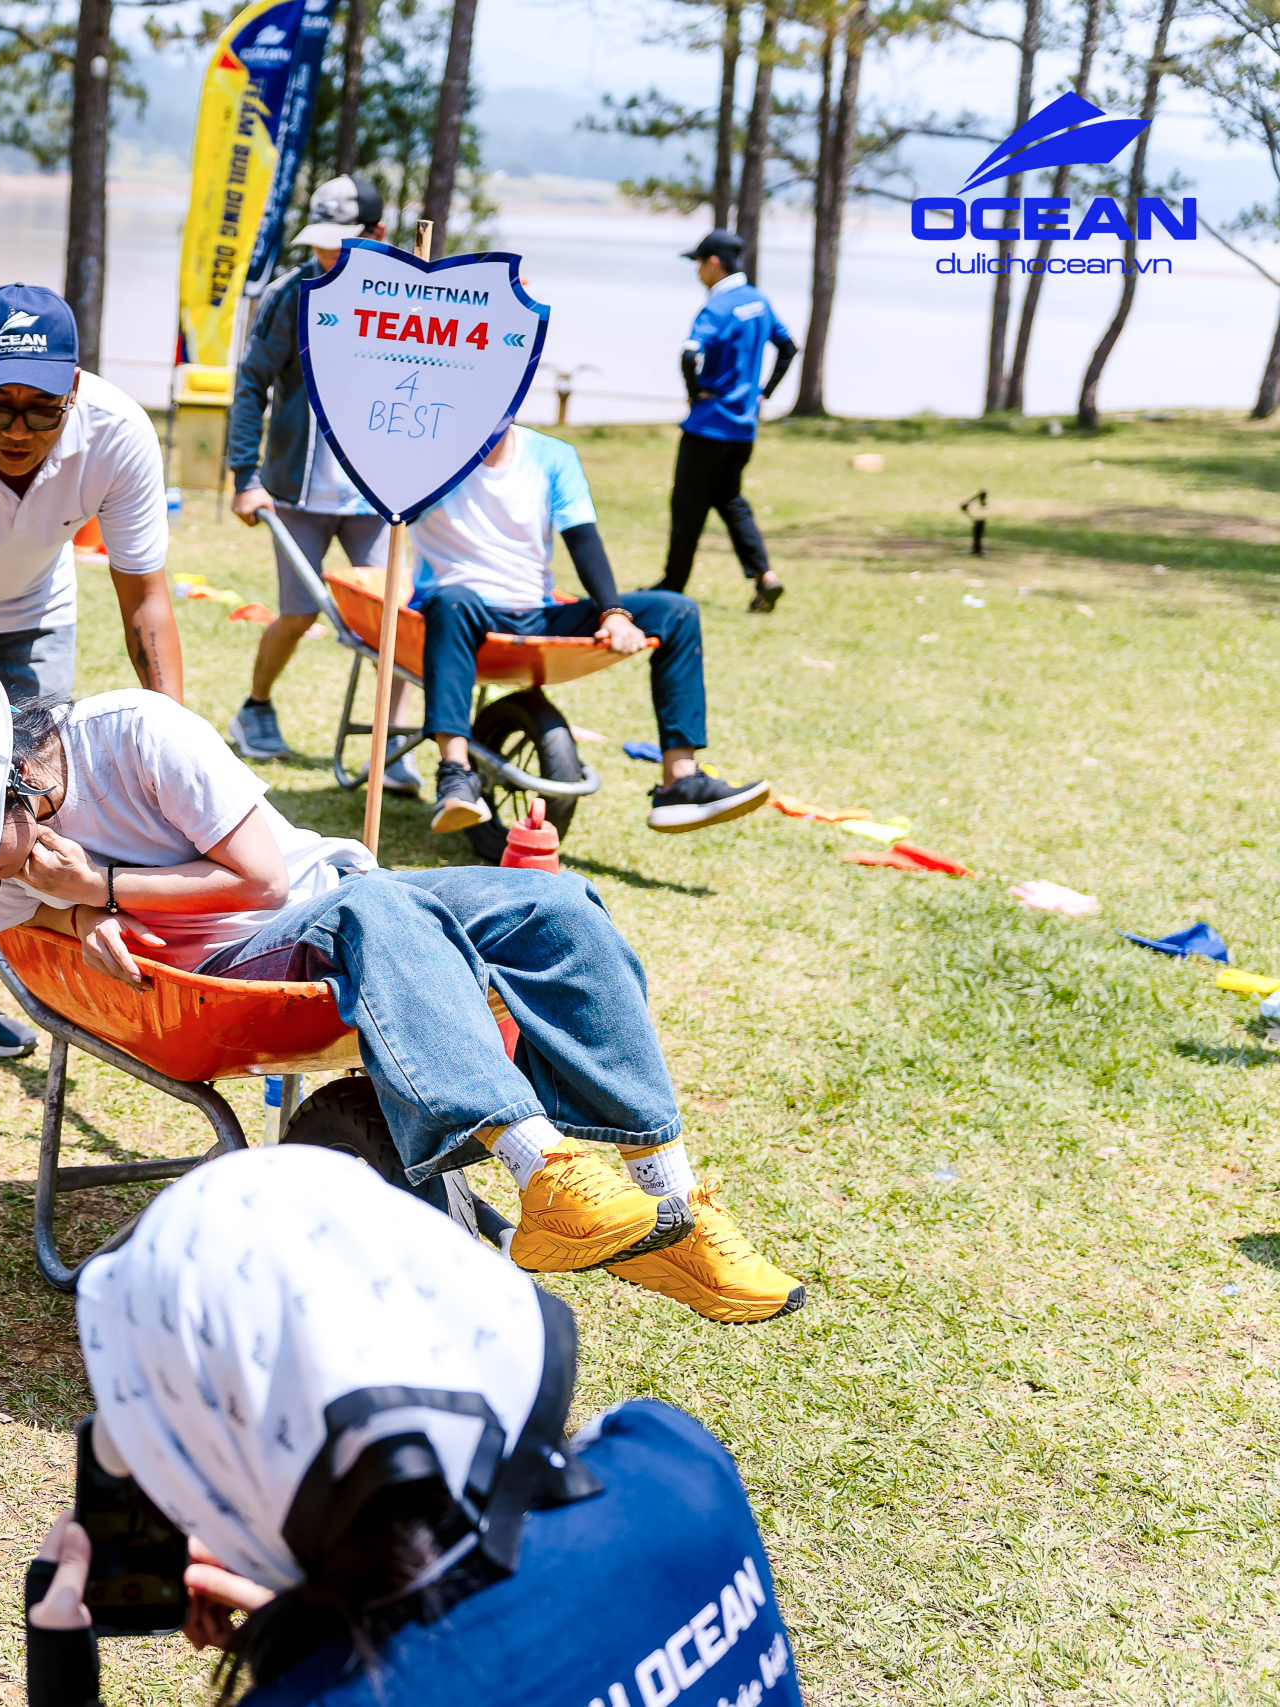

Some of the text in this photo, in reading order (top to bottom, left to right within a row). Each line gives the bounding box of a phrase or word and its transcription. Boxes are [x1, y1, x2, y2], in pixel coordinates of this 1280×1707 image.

[237, 77, 267, 136] TEAM
[218, 143, 250, 238] BUILDING
[211, 244, 236, 307] OCEAN
[361, 279, 489, 306] PCU VIETNAM
[354, 308, 489, 350] TEAM 4
[394, 370, 420, 402] 4
[368, 400, 456, 439] BEST
[634, 1555, 766, 1707] OCEAN
